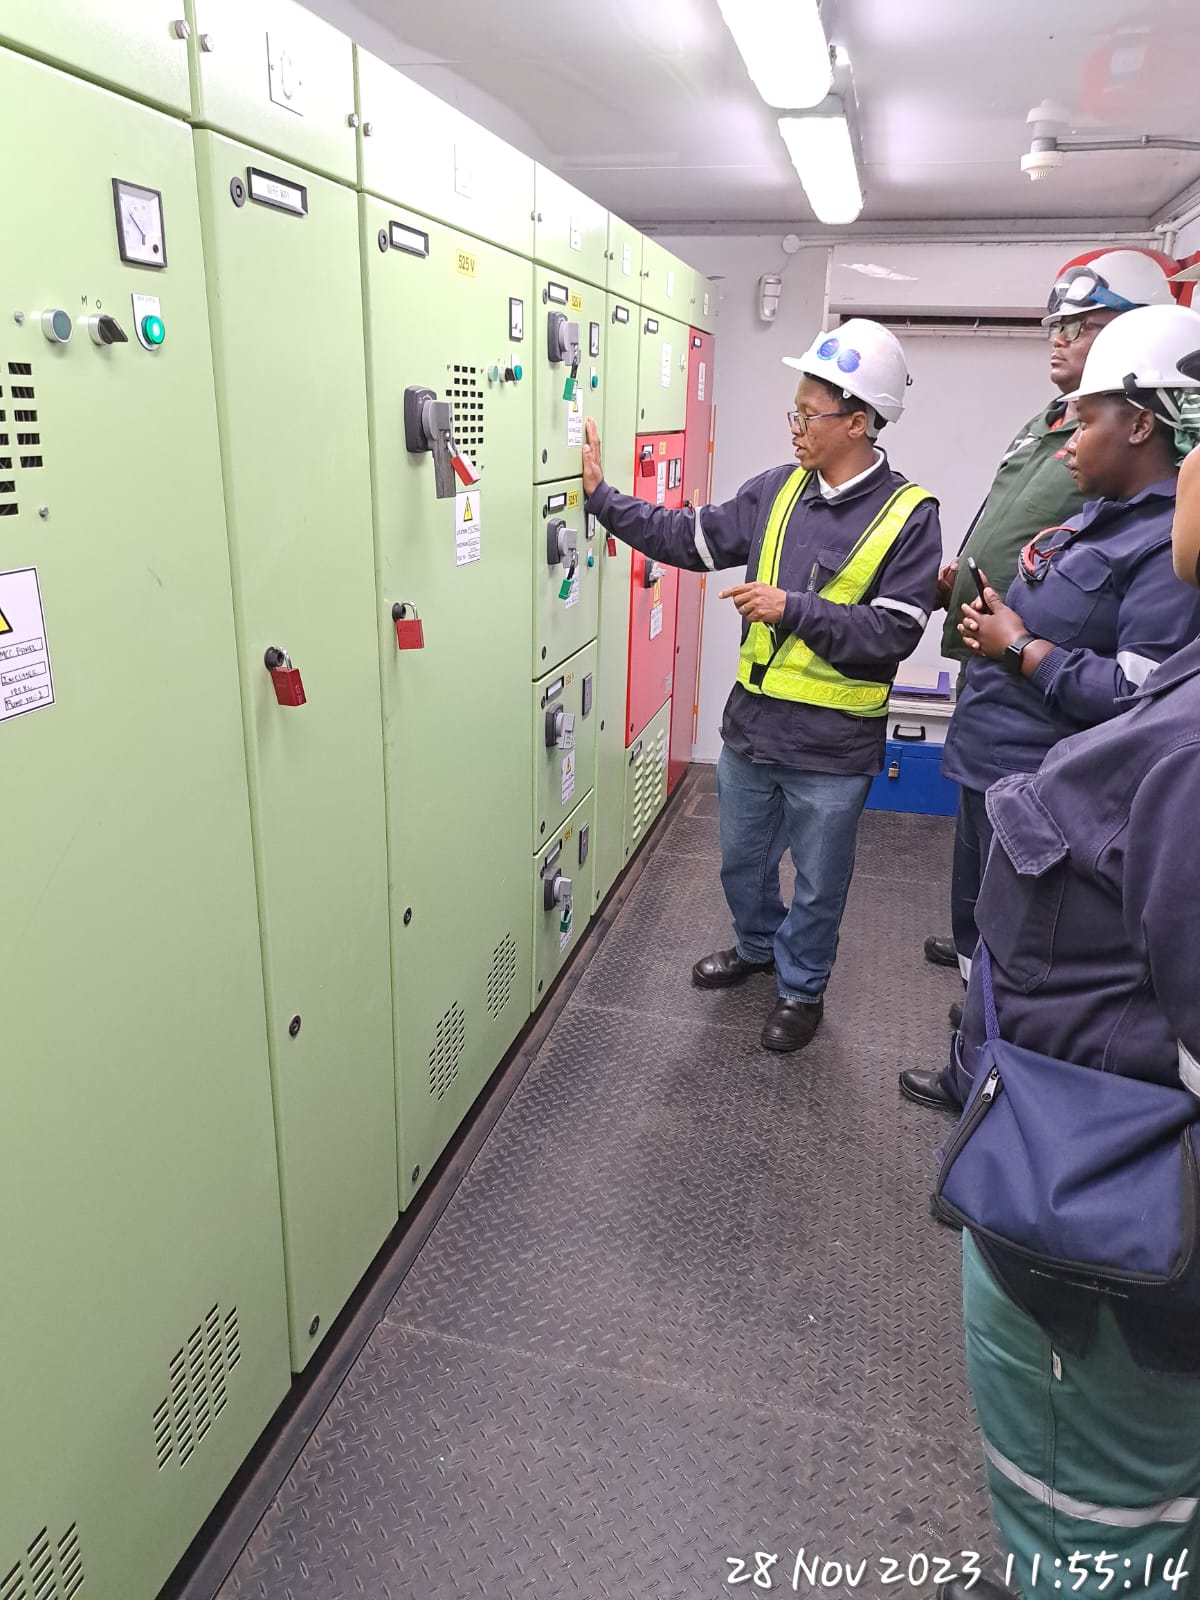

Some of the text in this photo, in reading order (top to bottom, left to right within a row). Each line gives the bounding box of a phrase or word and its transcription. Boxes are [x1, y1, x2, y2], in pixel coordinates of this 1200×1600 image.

[458, 254, 475, 273] 525 V
[81, 295, 88, 307] M
